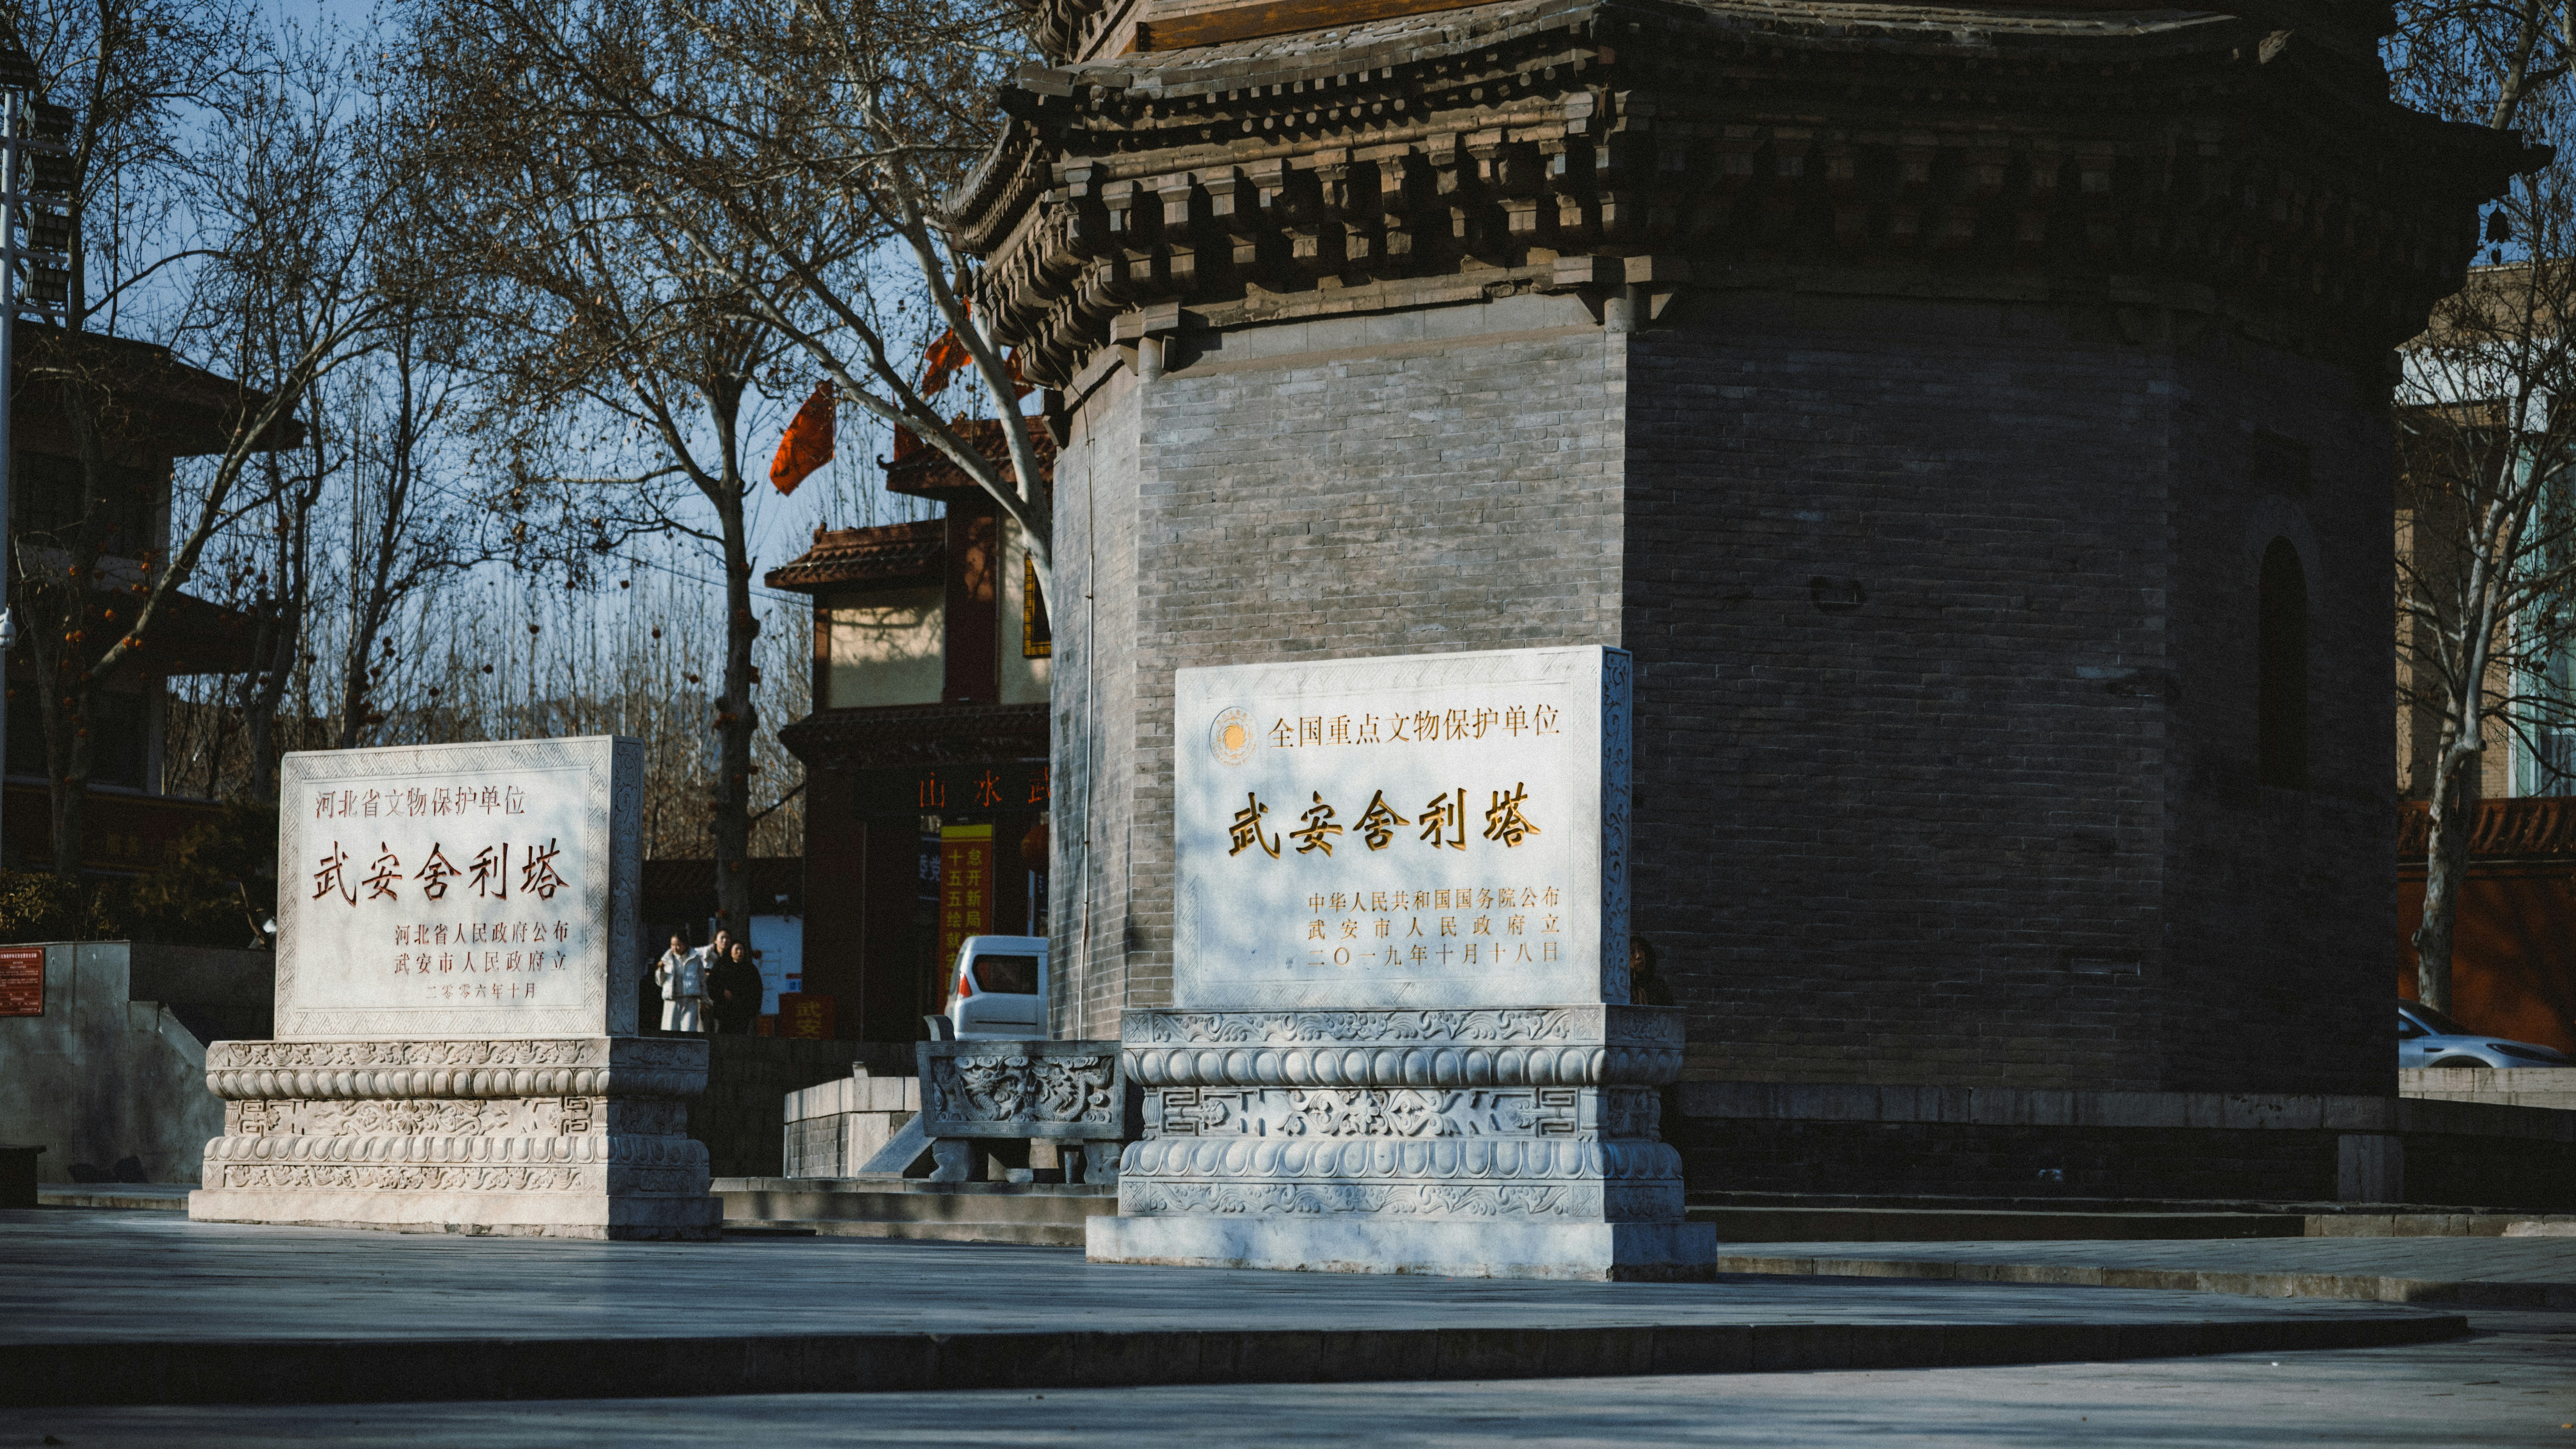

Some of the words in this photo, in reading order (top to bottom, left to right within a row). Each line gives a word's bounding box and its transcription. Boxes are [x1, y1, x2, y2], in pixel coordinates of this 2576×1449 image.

[1268, 704, 1560, 748] 全国重点文物保护单位
[316, 785, 526, 819] 河北省文物保护单位
[920, 766, 1050, 808] 山水武
[1228, 781, 1541, 860] 武安舍利塔
[312, 837, 569, 908] 武安舍利塔
[966, 848, 982, 936] 怠开新局
[1309, 886, 1559, 914] 中华人民共和国国务院公布
[395, 920, 568, 946] 河北省人民政府公布
[1308, 914, 1559, 940] 武安市人民政府立
[394, 950, 567, 975] 武安市人民政府立
[426, 983, 535, 1000] 二零零六年十月
[796, 1001, 822, 1039] 武安
